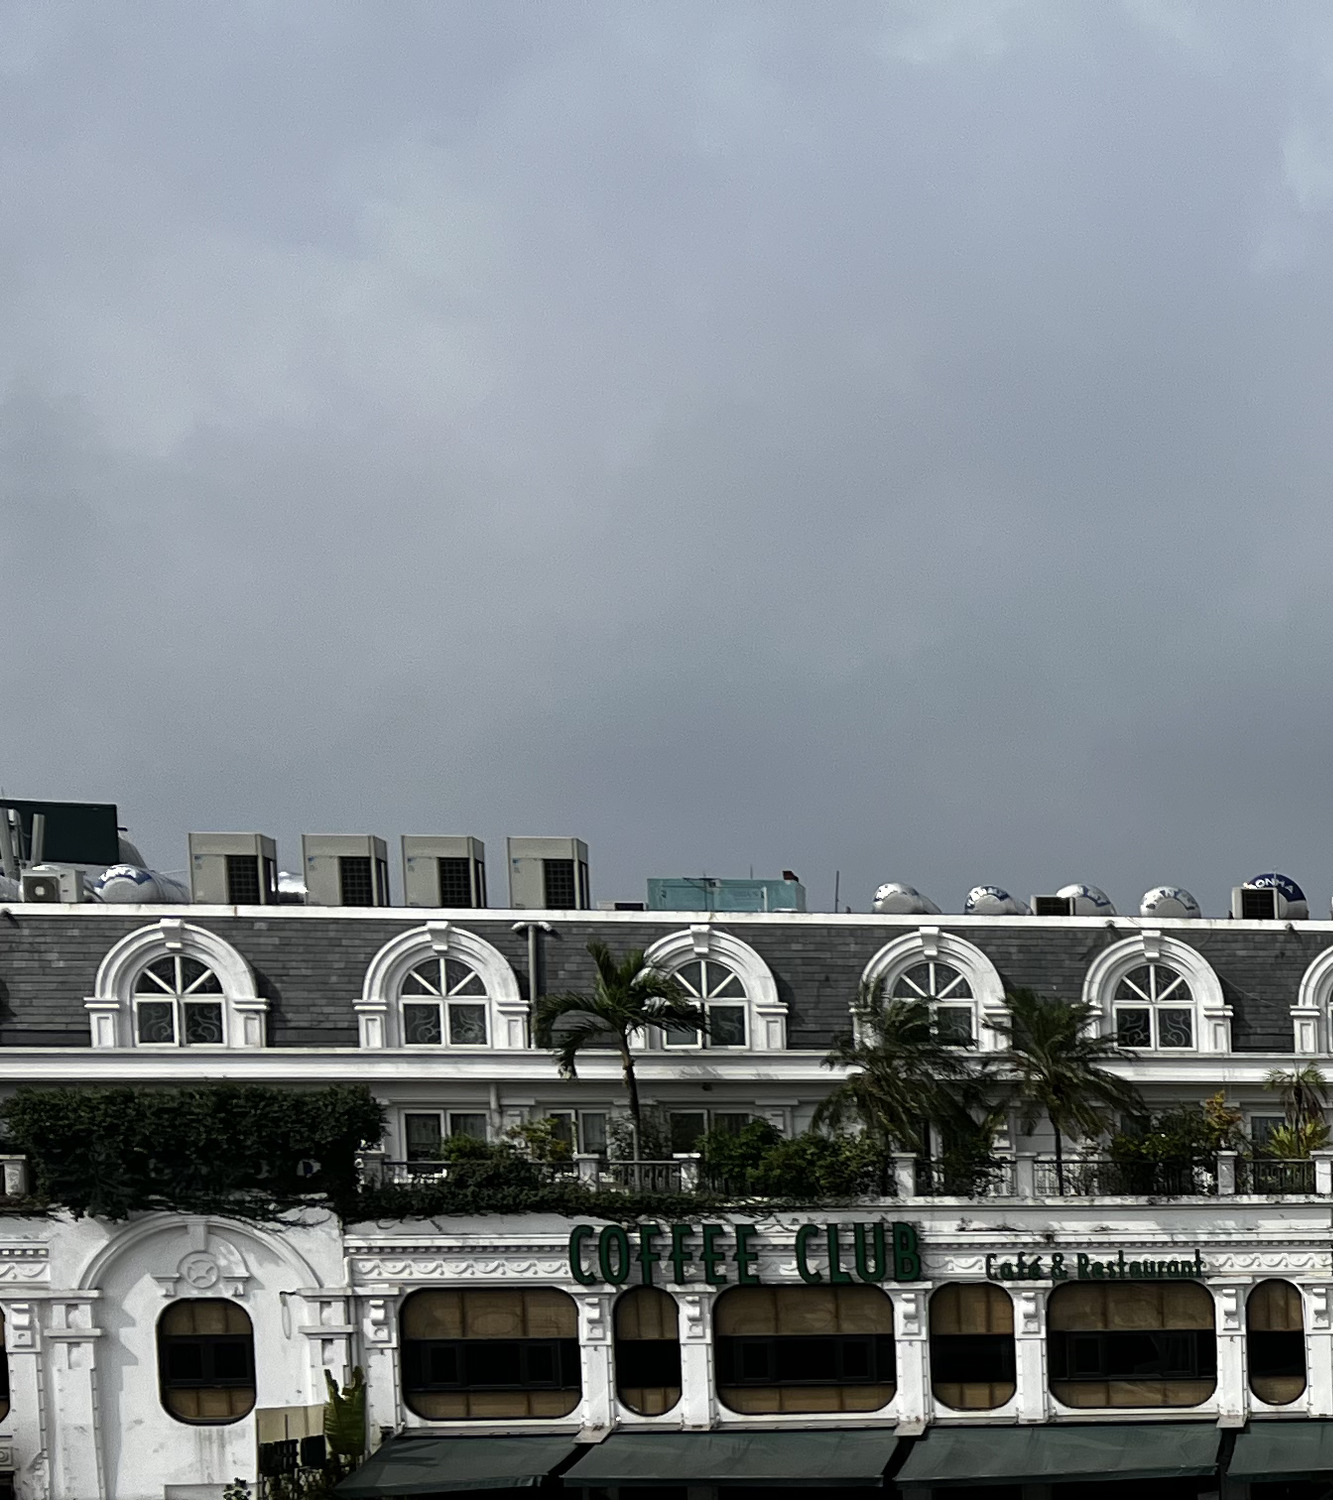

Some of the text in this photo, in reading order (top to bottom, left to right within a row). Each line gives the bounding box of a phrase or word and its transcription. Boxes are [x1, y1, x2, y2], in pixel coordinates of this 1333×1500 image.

[567, 1220, 922, 1287] COFFEE CLUB
[985, 1248, 1205, 1280] Café & Restaurant
